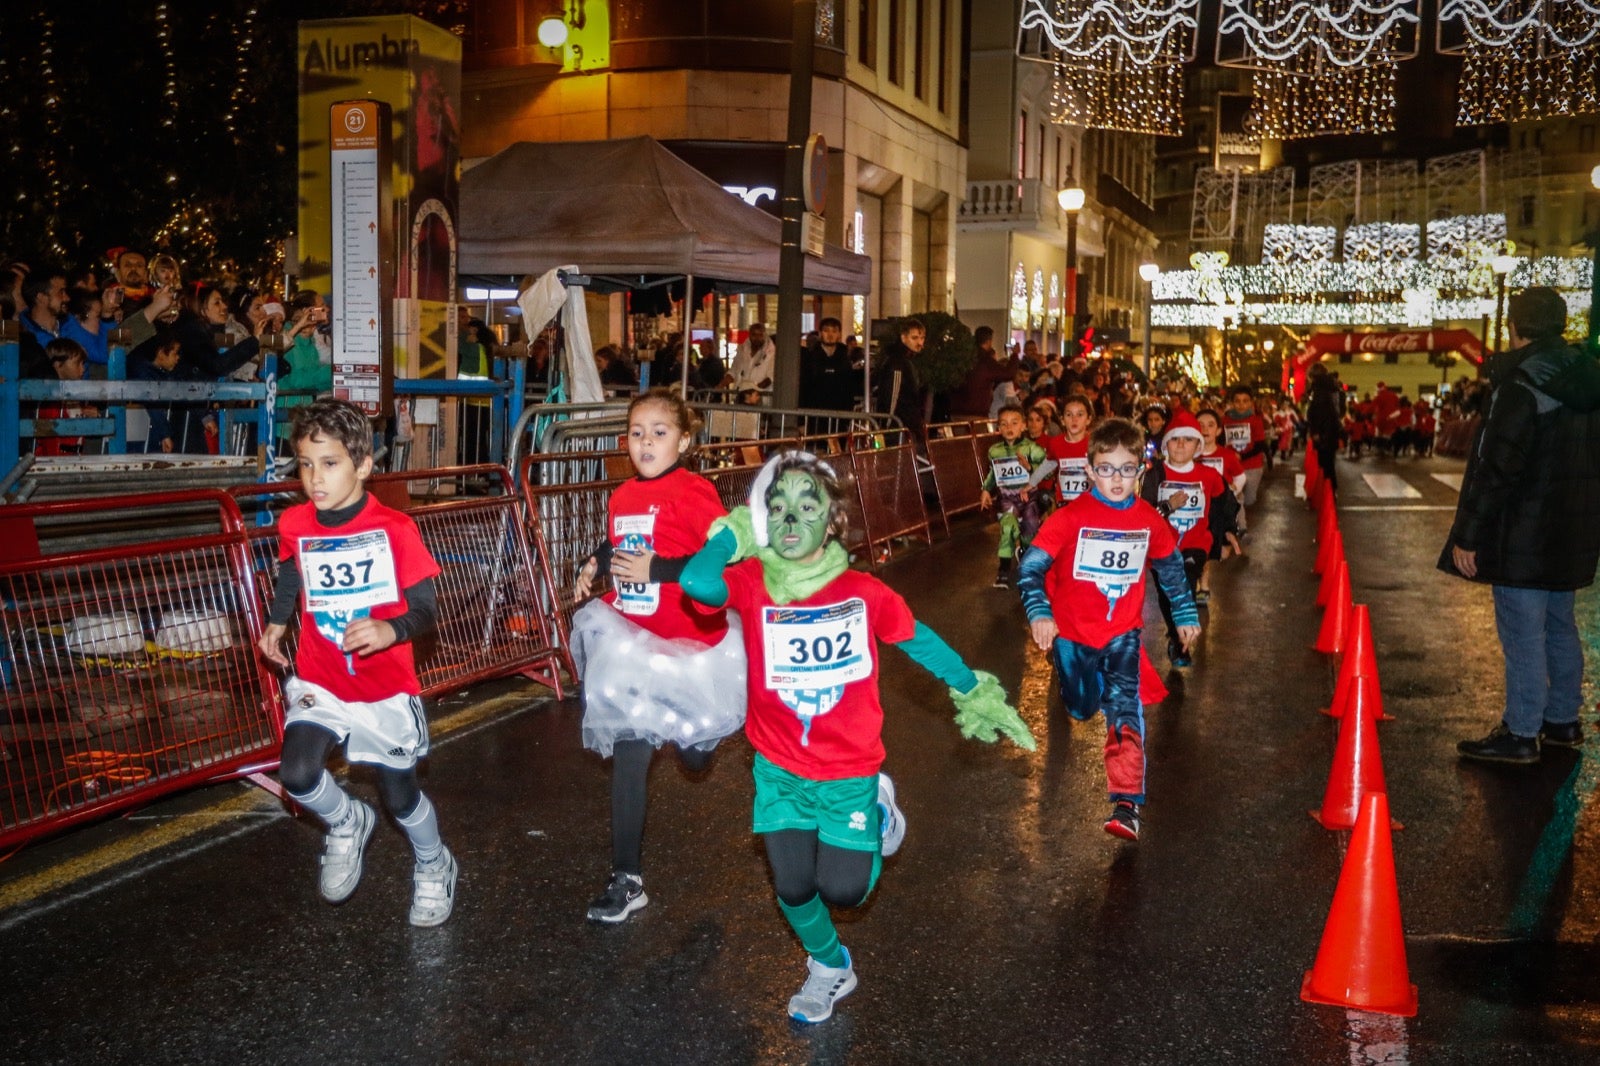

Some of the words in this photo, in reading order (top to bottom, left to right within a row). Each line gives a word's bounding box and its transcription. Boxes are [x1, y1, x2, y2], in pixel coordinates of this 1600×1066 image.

[349, 116, 361, 125] 21
[1001, 465, 1023, 478] 240
[1064, 480, 1089, 491] 179
[1100, 550, 1130, 569] 88
[318, 558, 375, 589] 337
[788, 631, 853, 664] 302
